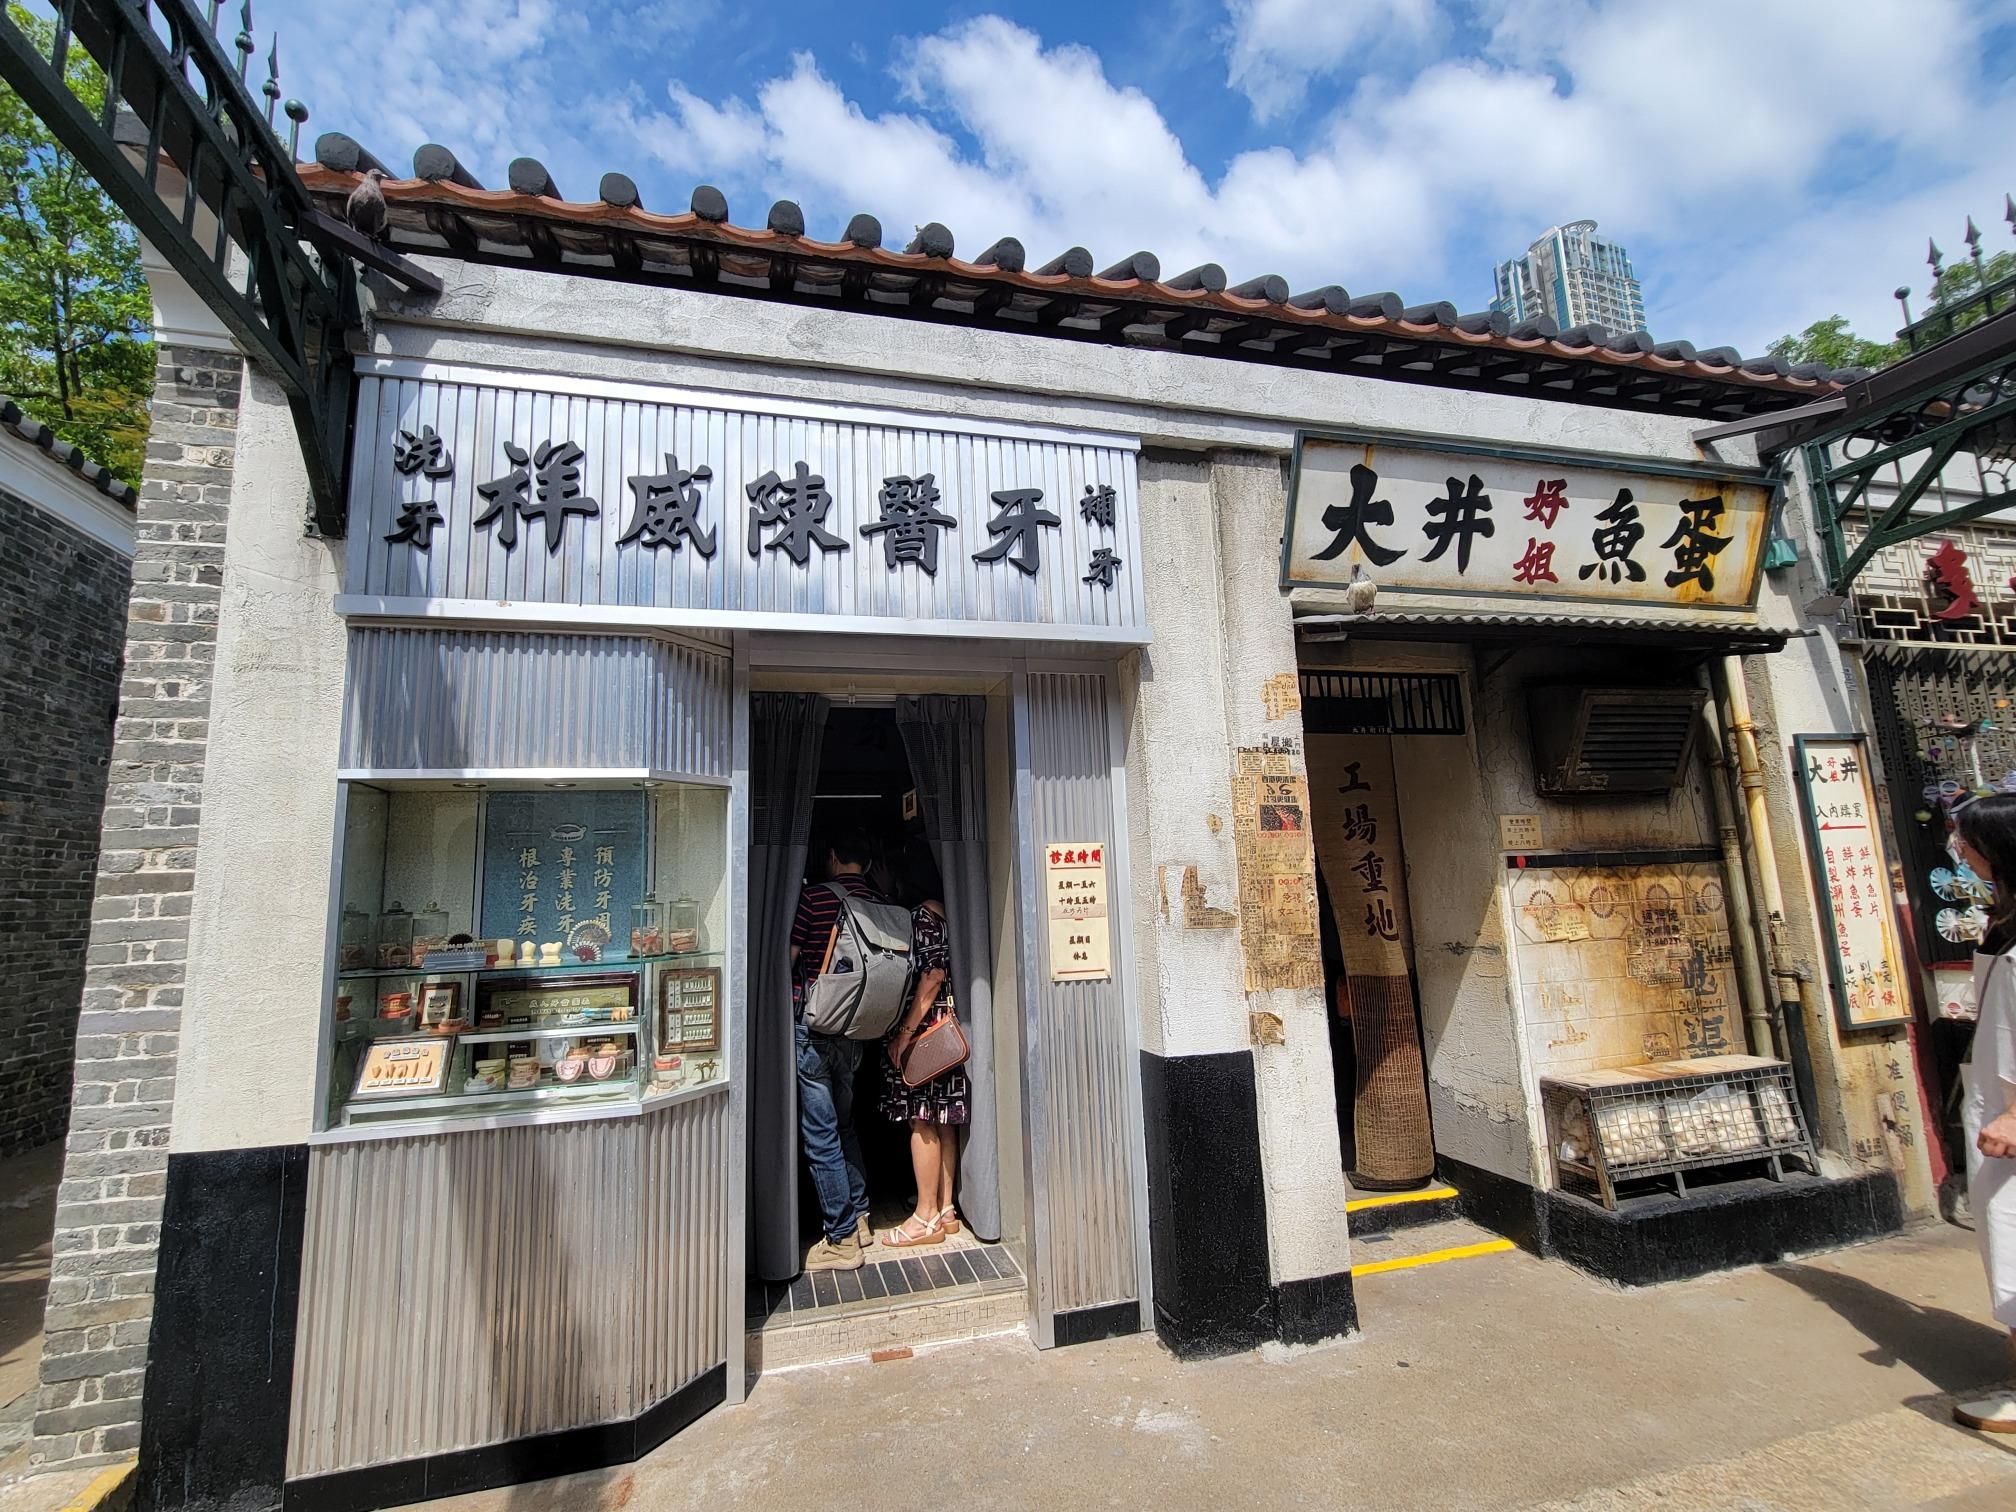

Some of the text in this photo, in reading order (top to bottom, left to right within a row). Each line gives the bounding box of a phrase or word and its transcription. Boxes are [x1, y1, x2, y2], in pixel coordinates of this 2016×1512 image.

[383, 424, 453, 550] 洗牙
[1079, 484, 1122, 587] 補牙
[1050, 849, 1101, 864] 診症時間
[1338, 761, 1400, 941] 工場重地
[517, 848, 541, 936] 根治牙疾
[555, 846, 577, 934] 專業洗牙
[1058, 880, 1096, 889] 星期一至六
[1059, 896, 1096, 905] 十時至五時
[1069, 935, 1091, 945] 星期日
[1073, 952, 1088, 960] 休息
